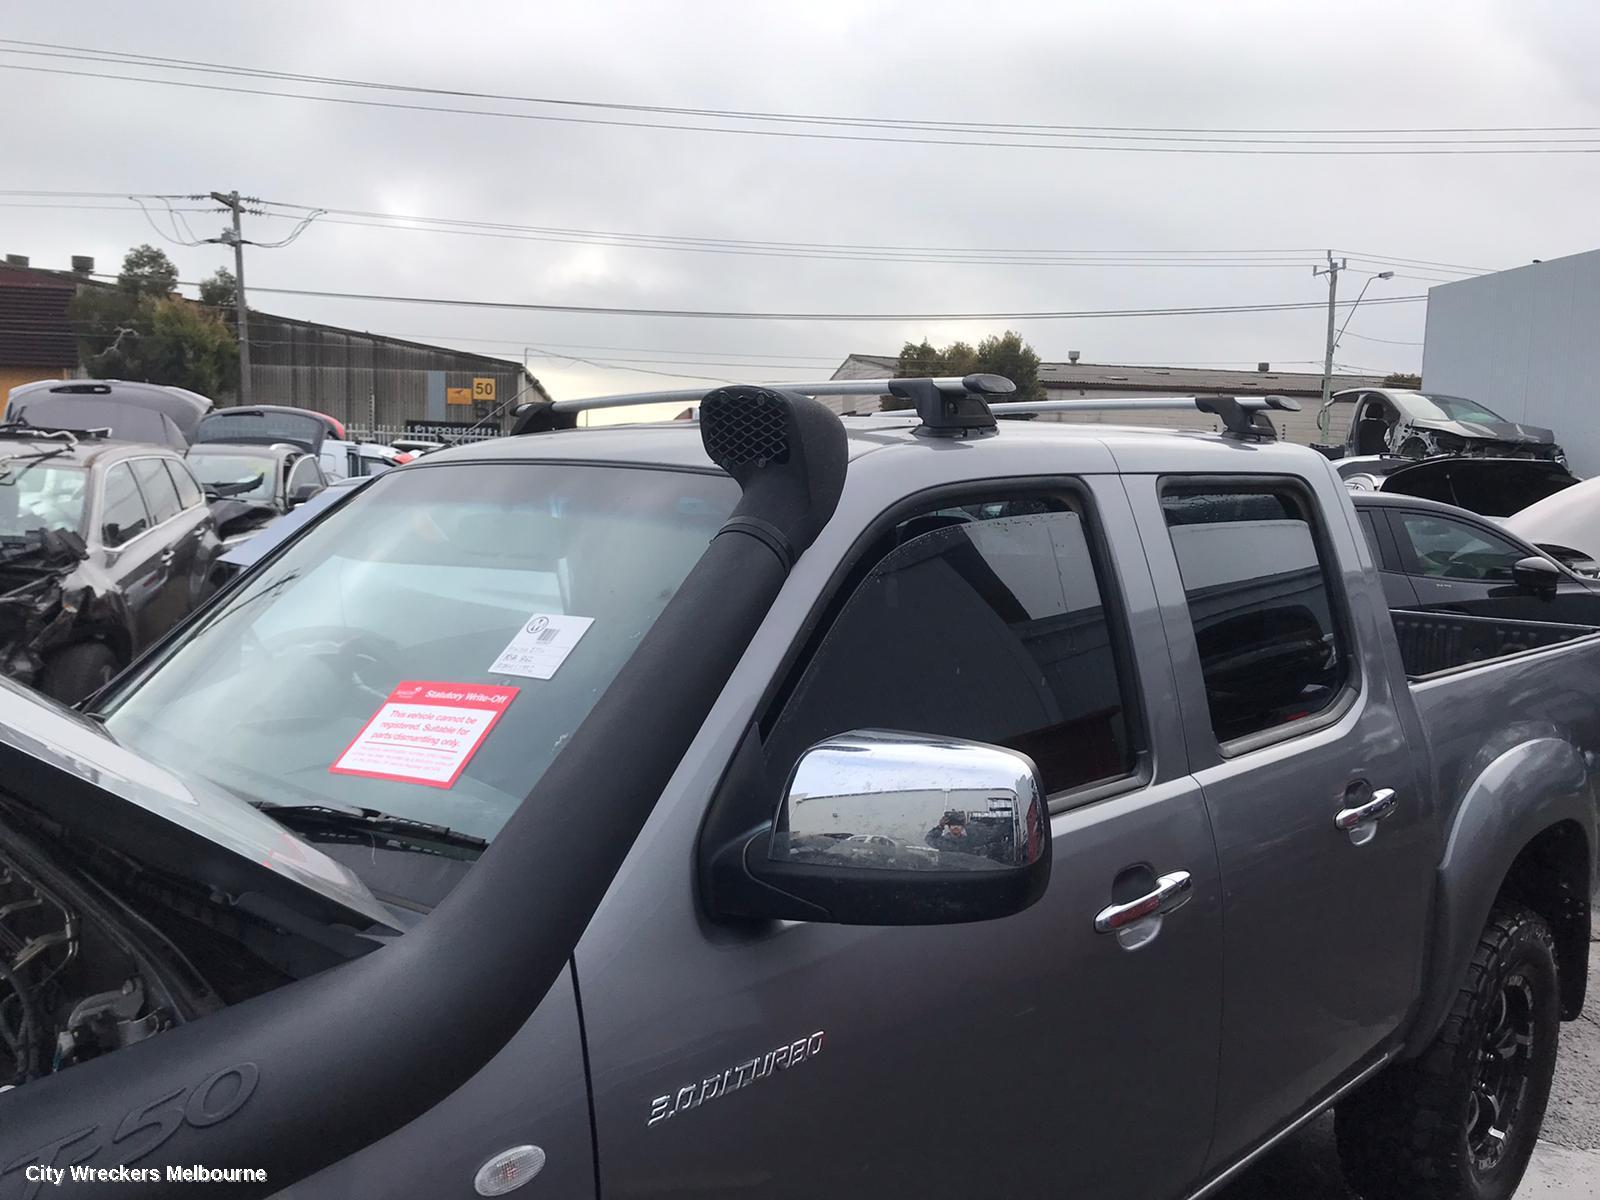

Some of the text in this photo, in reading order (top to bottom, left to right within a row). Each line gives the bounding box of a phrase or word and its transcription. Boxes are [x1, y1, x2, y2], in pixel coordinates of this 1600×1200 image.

[475, 382, 493, 395] 50
[425, 690, 465, 702] Statutory
[466, 692, 508, 704] Write-Off
[390, 709, 478, 725] This vehicle cannot be
[422, 723, 456, 734] Suitable
[456, 726, 471, 736] for
